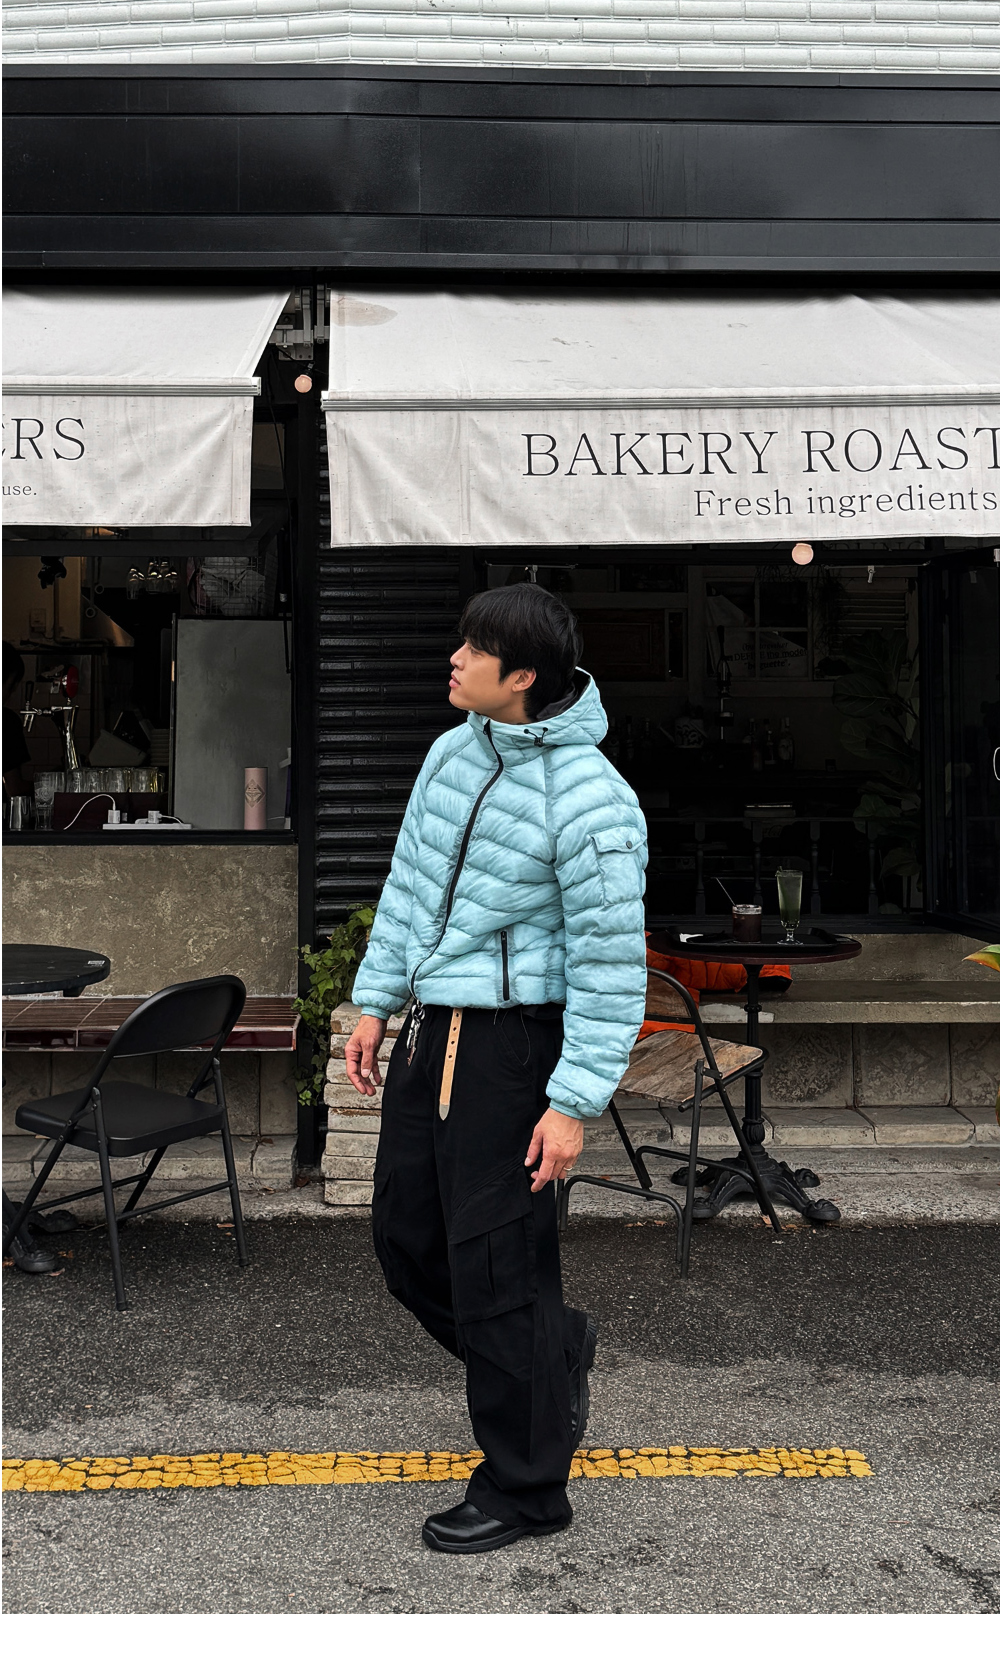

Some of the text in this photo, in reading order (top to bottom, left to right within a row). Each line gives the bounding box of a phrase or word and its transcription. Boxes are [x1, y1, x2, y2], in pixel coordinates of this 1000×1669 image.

[2, 417, 85, 461] RS
[521, 426, 1000, 477] BAKERY ROAST
[2, 484, 37, 496] use.
[694, 484, 998, 519] Fresh ingredients
[734, 651, 766, 662] DEFIE
